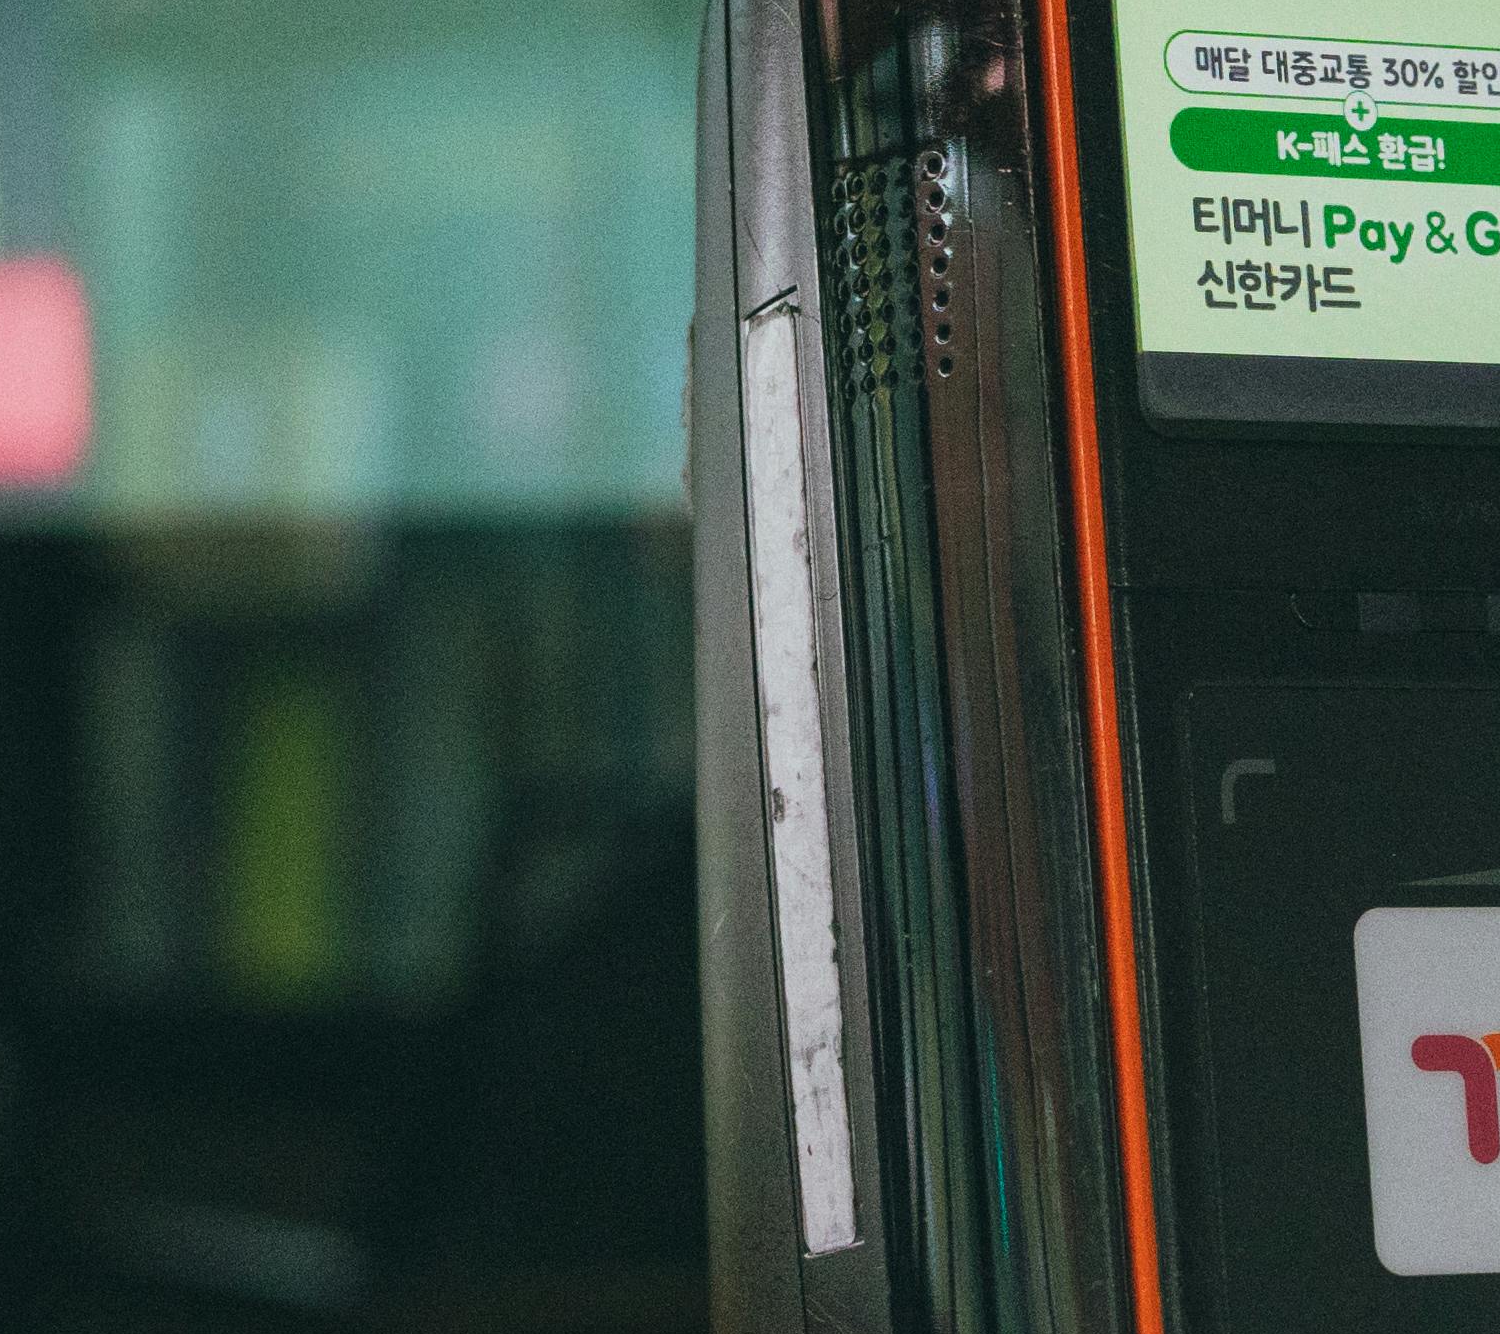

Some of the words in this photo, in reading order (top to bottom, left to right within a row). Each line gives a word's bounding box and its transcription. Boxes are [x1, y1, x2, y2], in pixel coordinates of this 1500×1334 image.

[1194, 46, 1252, 83] 매달
[1261, 50, 1373, 90] 대중교통
[1381, 56, 1445, 89] 30%
[1276, 129, 1372, 168] K-패스
[1377, 131, 1446, 173] 환급!
[1192, 195, 1312, 249] 티머니
[1323, 203, 1415, 264] Pay
[1196, 259, 1363, 313] 신한카드
